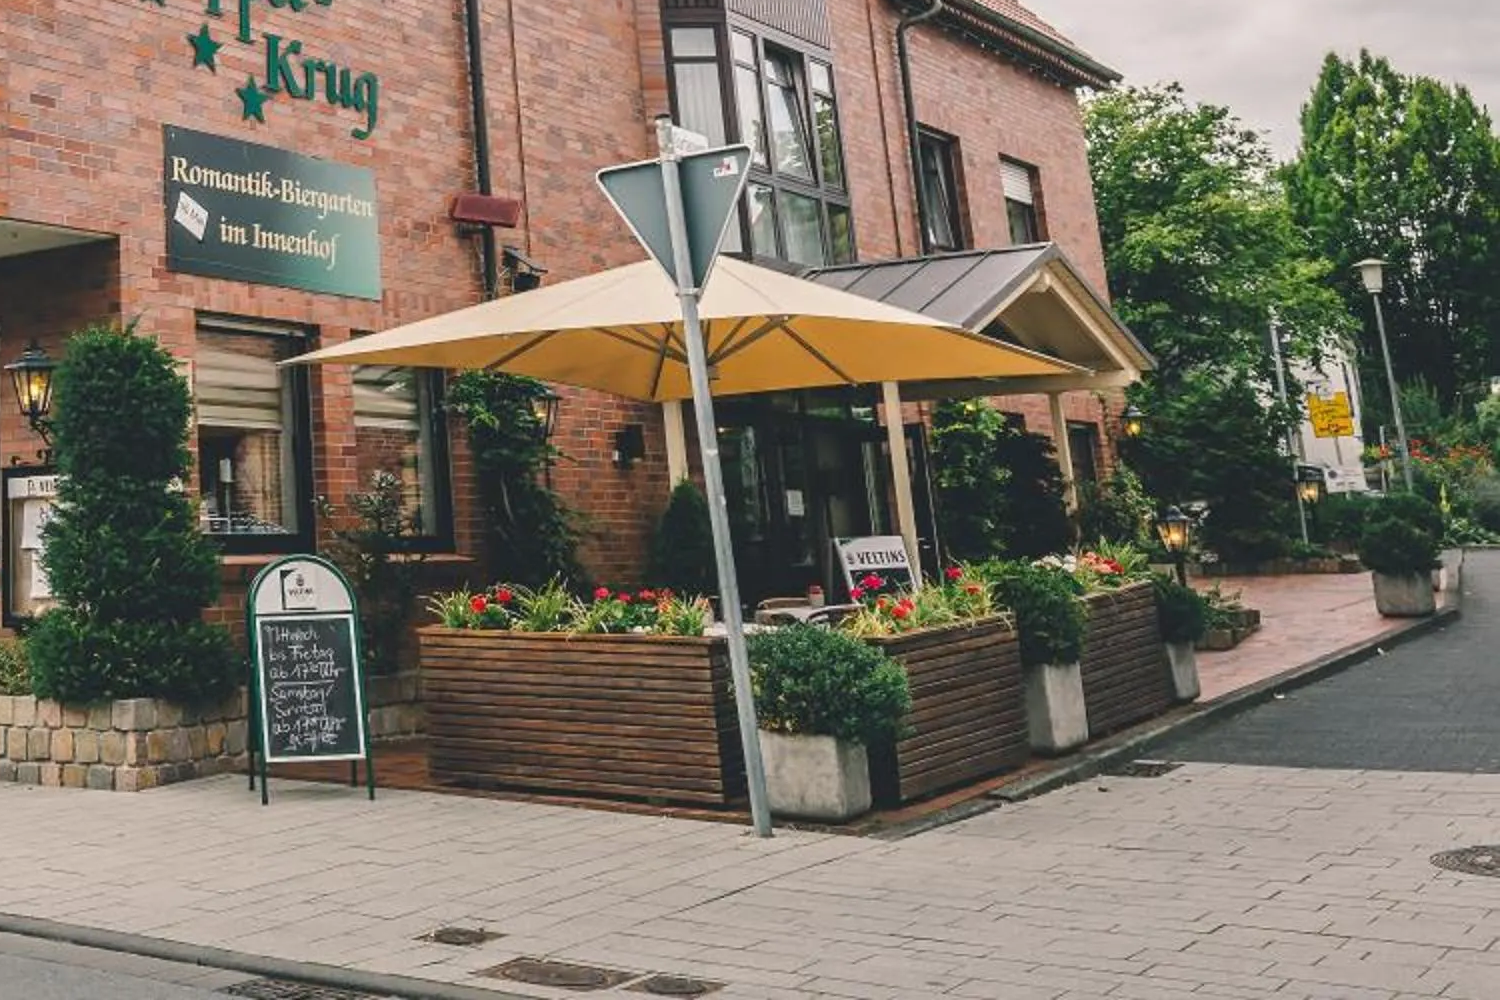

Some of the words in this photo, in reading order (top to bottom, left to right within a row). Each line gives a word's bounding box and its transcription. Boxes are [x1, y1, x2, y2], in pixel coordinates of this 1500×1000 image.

[262, 32, 381, 140] Krug
[171, 156, 375, 220] Romantik-Biergarten
[219, 216, 248, 246] im
[252, 224, 342, 271] Innenhof
[856, 549, 906, 566] VELTINS
